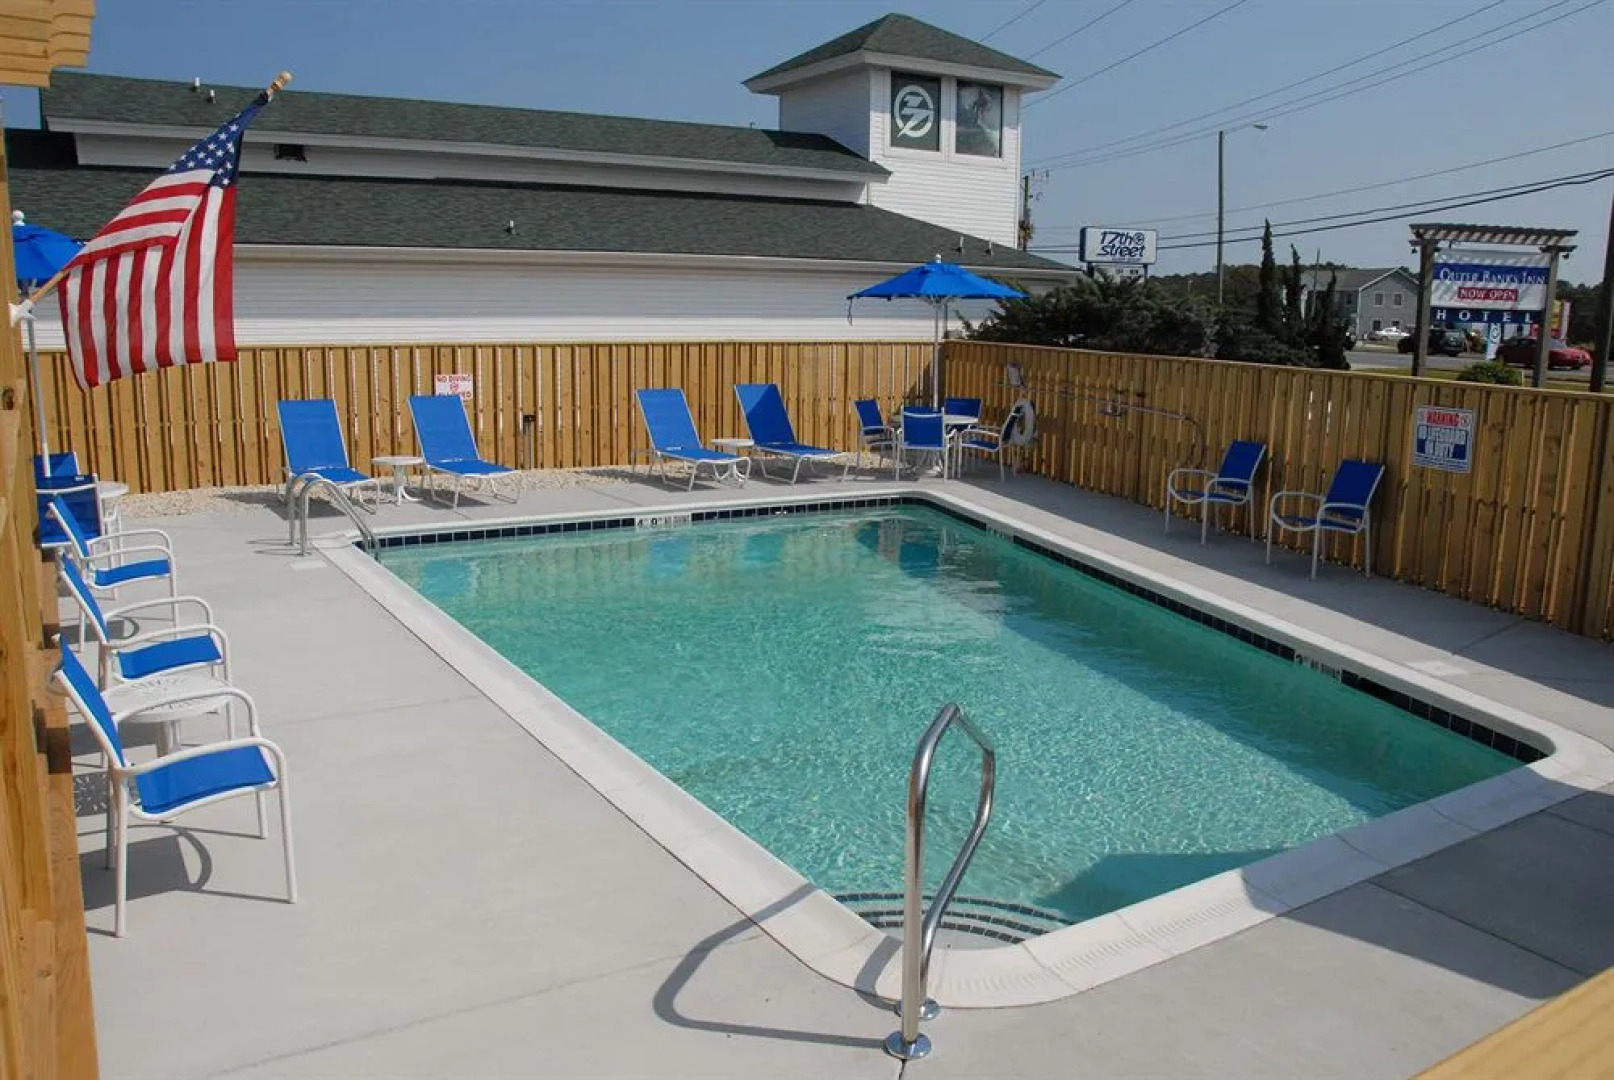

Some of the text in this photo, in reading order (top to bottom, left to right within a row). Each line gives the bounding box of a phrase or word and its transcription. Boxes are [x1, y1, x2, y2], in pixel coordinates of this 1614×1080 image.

[1100, 231, 1133, 245] 17th
[1460, 288, 1516, 300] NOW OPEN
[1436, 309, 1533, 323] HOTEL
